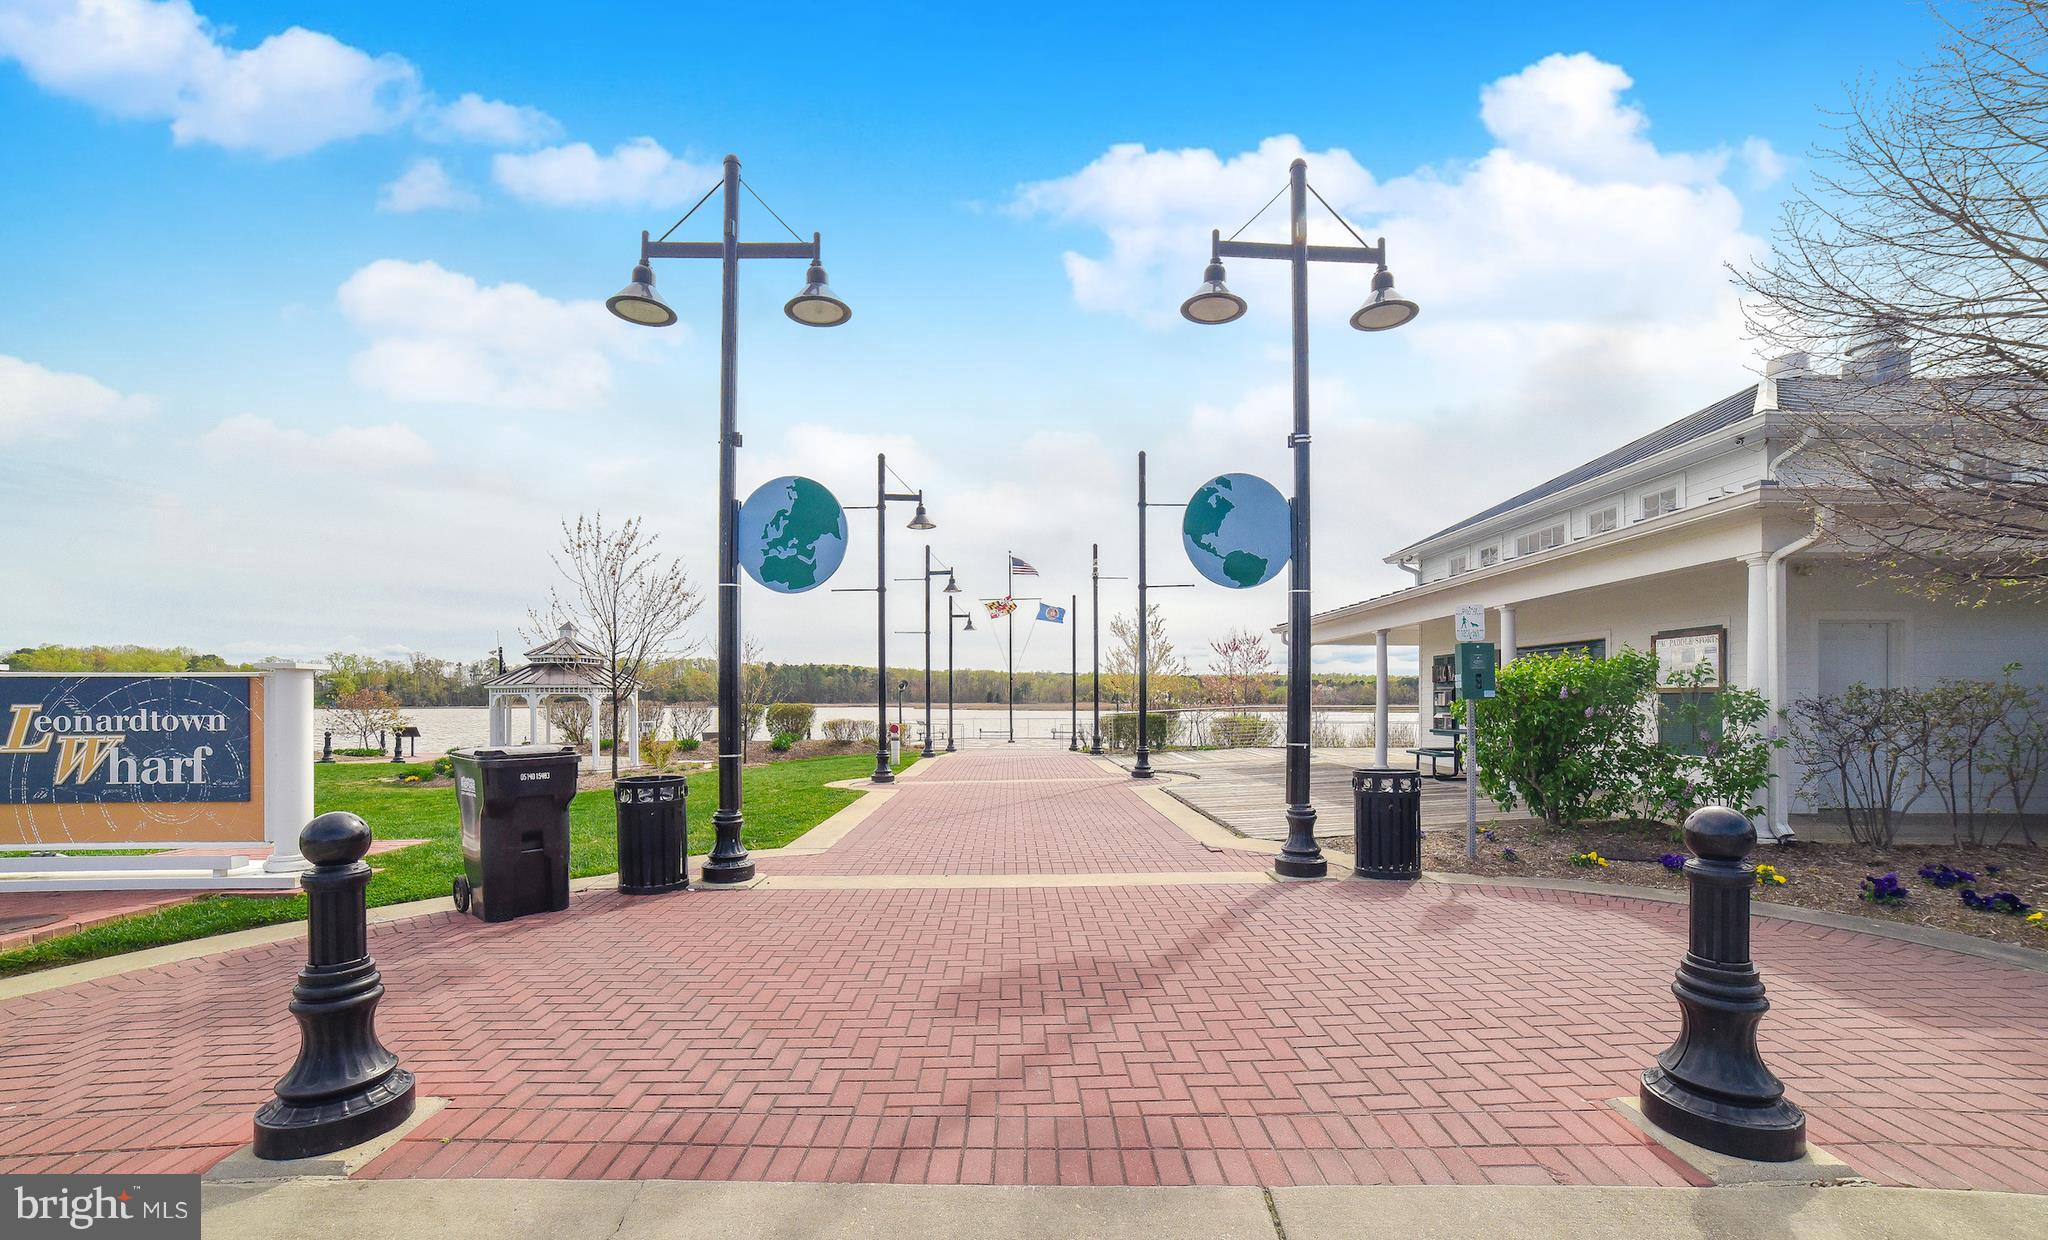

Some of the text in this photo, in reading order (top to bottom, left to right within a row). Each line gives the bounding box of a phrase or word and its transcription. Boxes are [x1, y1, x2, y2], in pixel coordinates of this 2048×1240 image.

[1696, 636, 1718, 645] SPORTS
[1, 703, 227, 753] Leonardtown
[53, 735, 214, 786] Wharf
